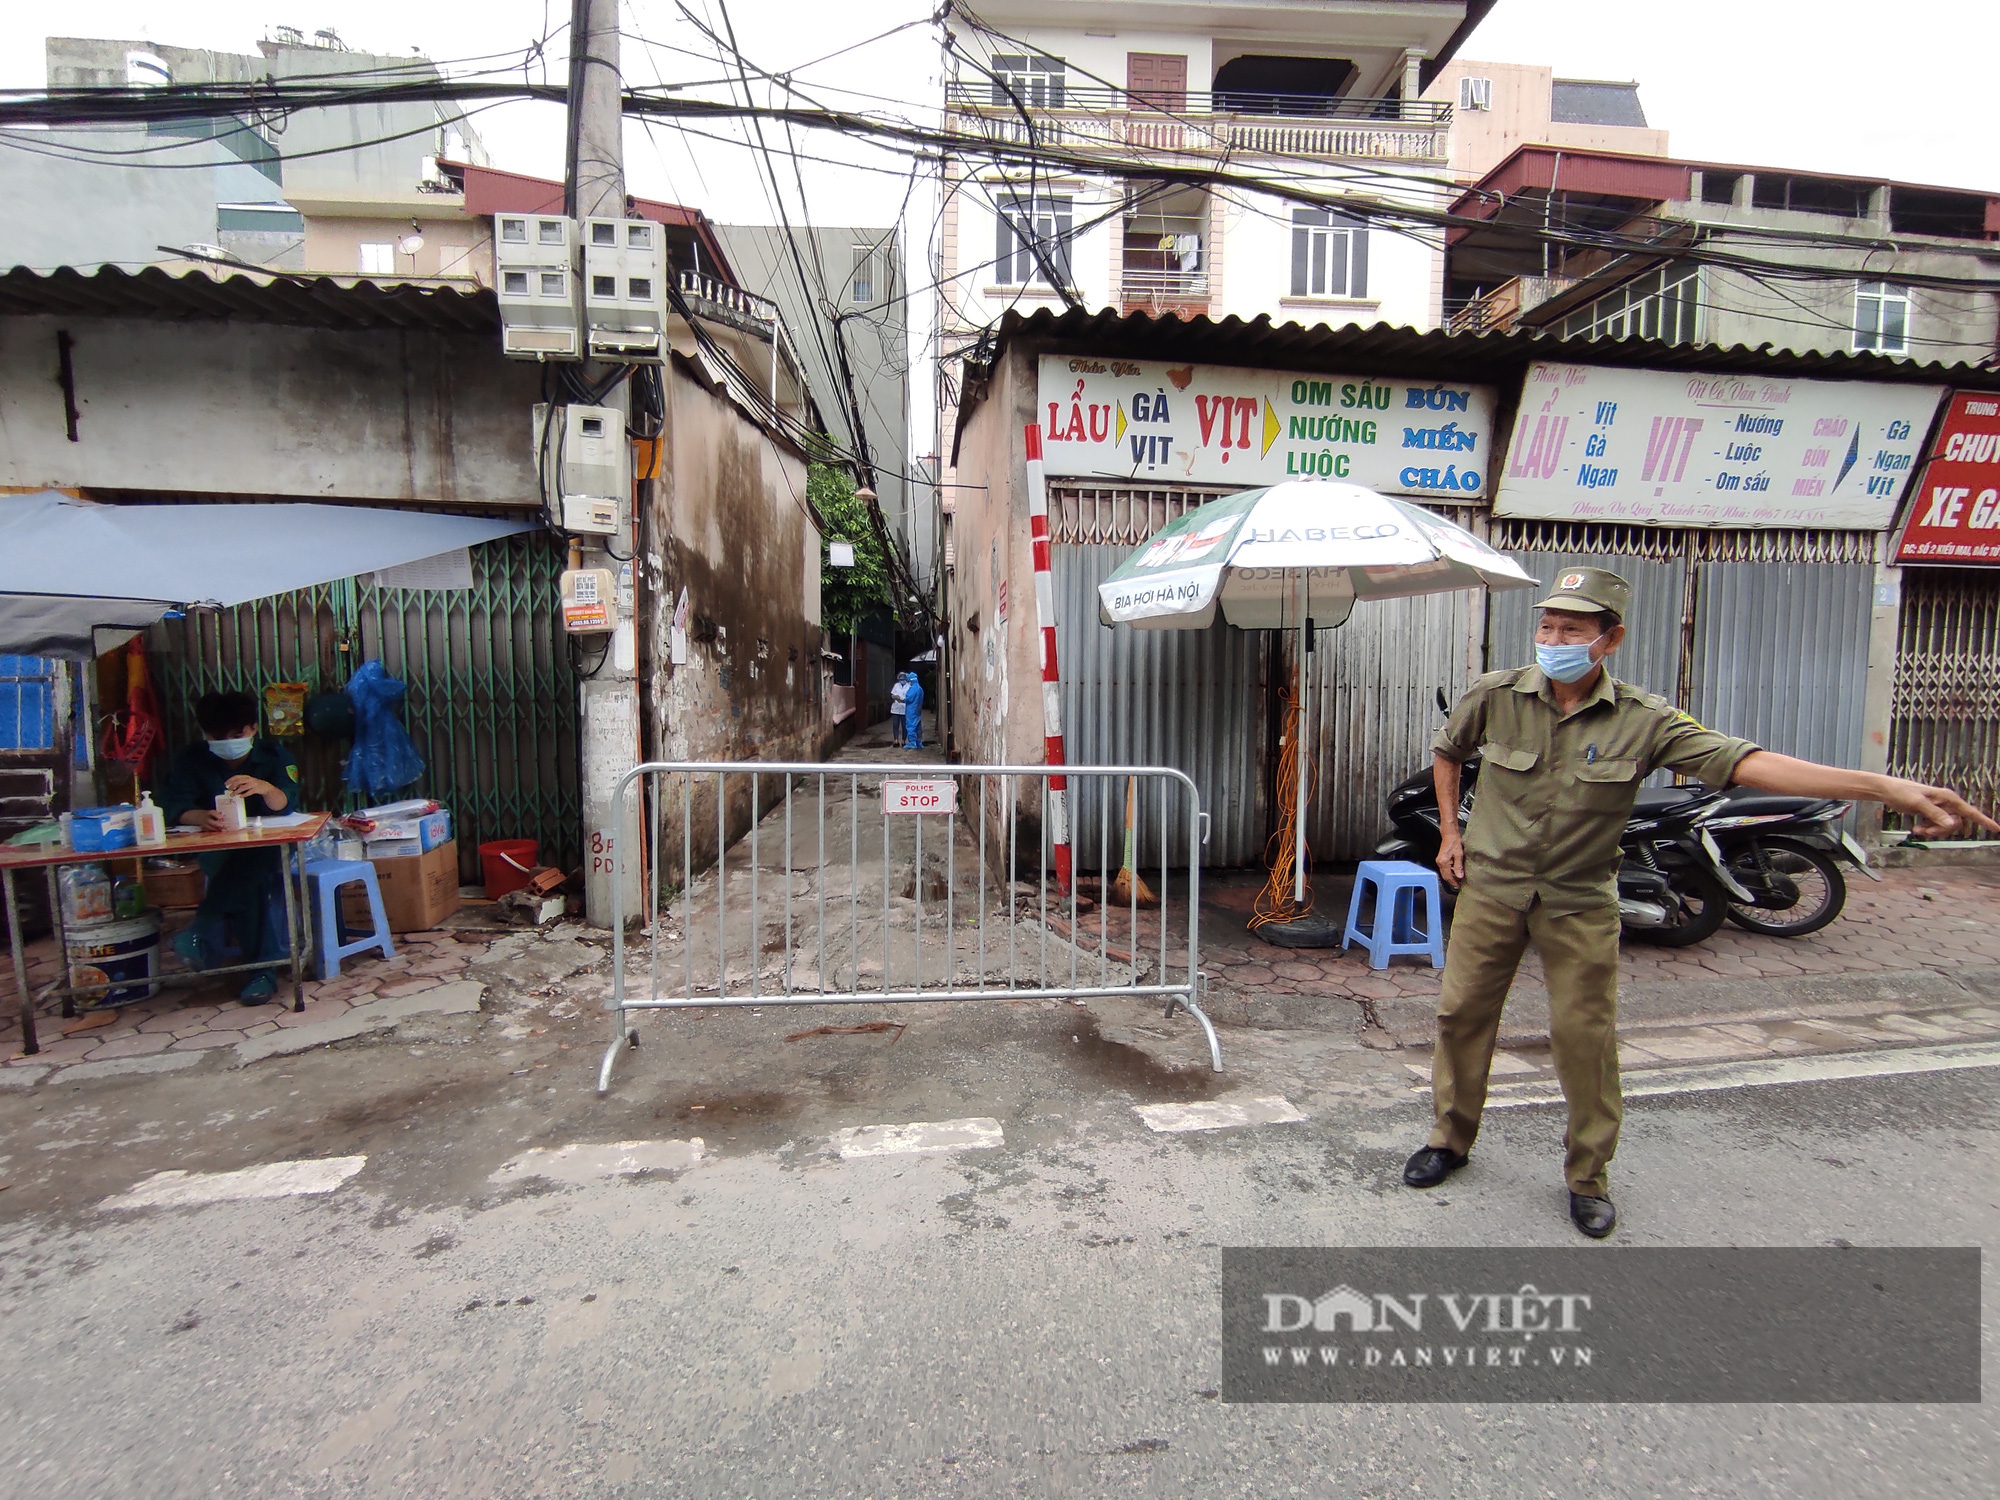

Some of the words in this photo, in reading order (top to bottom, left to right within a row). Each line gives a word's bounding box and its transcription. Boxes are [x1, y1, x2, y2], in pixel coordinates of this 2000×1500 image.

[1131, 387, 1171, 424] GÀ
[1291, 380, 1332, 407] OM
[1404, 383, 1471, 413] BÚN
[1047, 378, 1111, 443] LẨU
[1594, 401, 1618, 431] Vịt
[1964, 401, 1999, 417] TRUNG
[1194, 394, 1258, 465] VỊT
[1288, 413, 1377, 445] NƯỚNG
[1401, 421, 1478, 453] MIẾN
[1508, 387, 1569, 480] LẨU
[1734, 413, 1784, 437] Nướng
[1130, 434, 1174, 471] VỊT
[1585, 433, 1607, 458] Gà
[1640, 416, 1705, 497] VỊT
[1724, 442, 1762, 466] Luộc
[1801, 444, 1831, 468] BÚN
[1286, 448, 1350, 482] LUỘC
[1873, 449, 1911, 472] Ngan
[1398, 464, 1481, 492] CHÁO
[1576, 463, 1619, 489] Ngan
[1715, 471, 1741, 491] Om
[1742, 469, 1771, 492] sấu
[1866, 475, 1896, 500] Vịt
[1919, 486, 1971, 528] XE
[1251, 523, 1400, 543] HABECO
[1114, 595, 1132, 610] BIA
[1133, 589, 1155, 606] HƠI
[1156, 584, 1175, 602] HÀ
[1177, 580, 1200, 602] NỘI
[900, 795, 940, 807] STOP
[905, 784, 934, 792] POLICE
